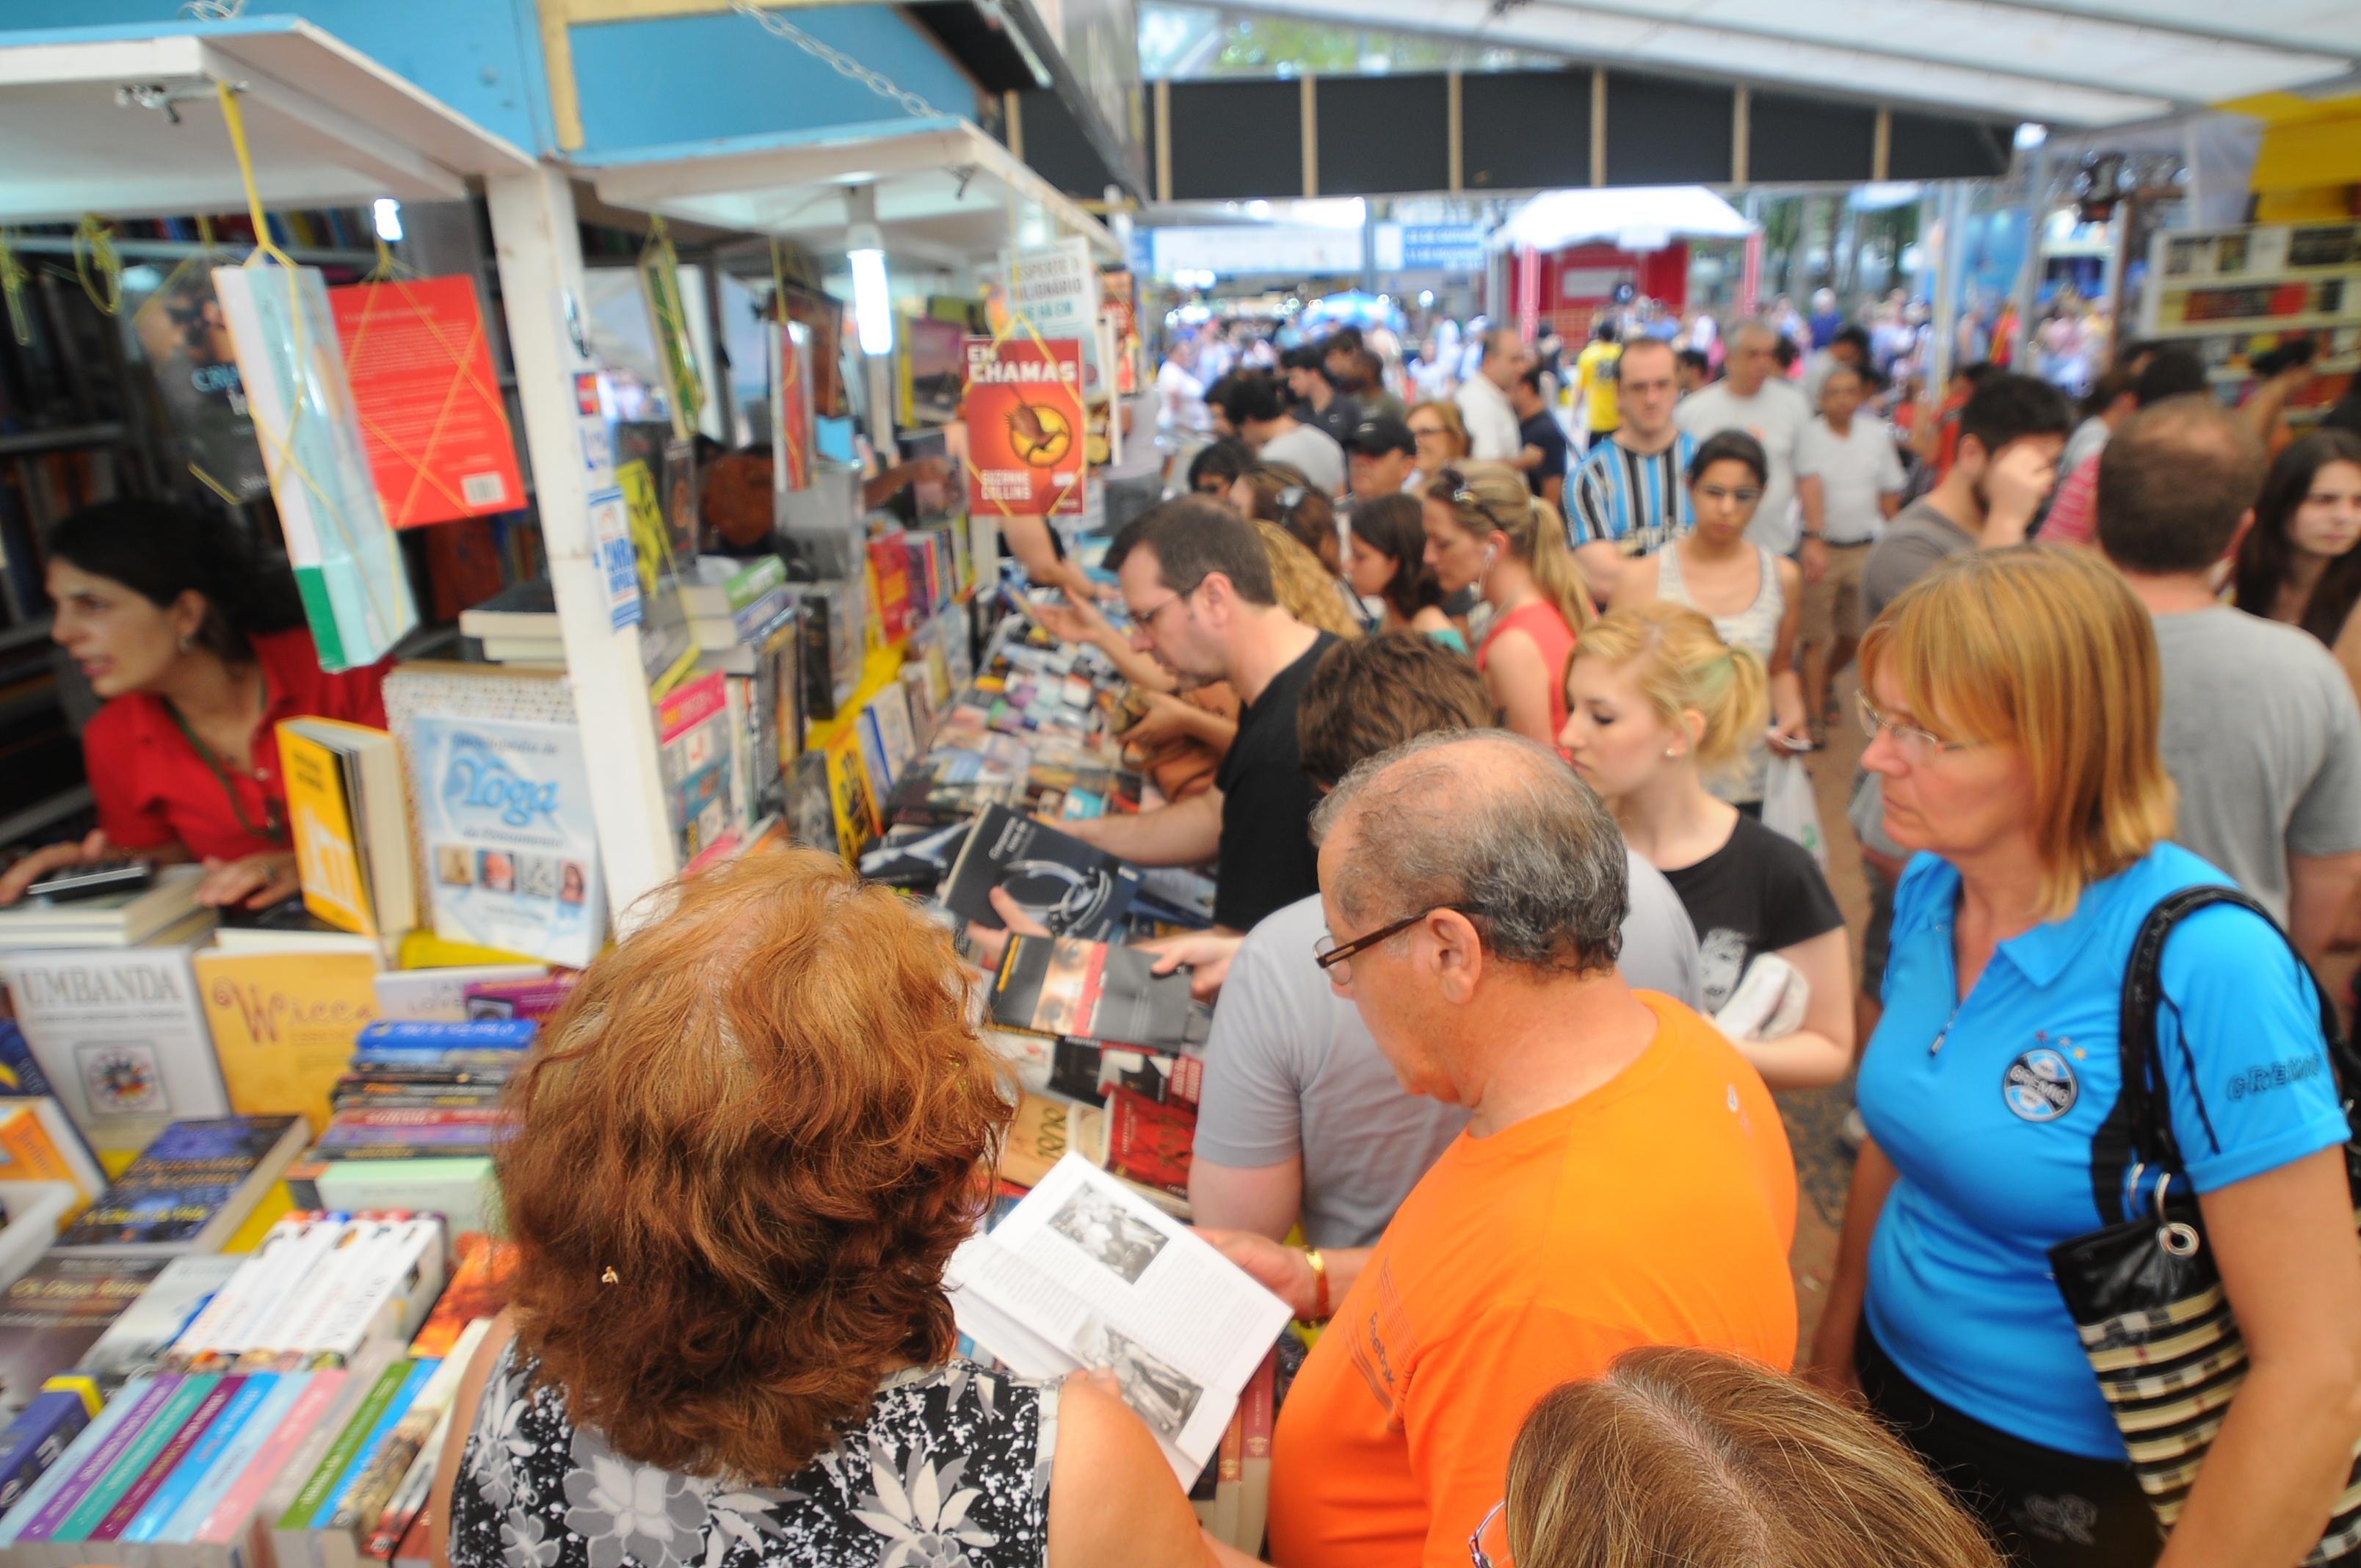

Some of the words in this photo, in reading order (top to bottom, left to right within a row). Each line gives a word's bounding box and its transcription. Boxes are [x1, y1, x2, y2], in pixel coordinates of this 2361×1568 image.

[968, 360, 1076, 383] CHAMAS
[445, 755, 560, 827] Yoga
[18, 964, 182, 1004] UMBANDA
[211, 975, 374, 1044] Wicca
[1368, 1310, 1395, 1382] Reebok
